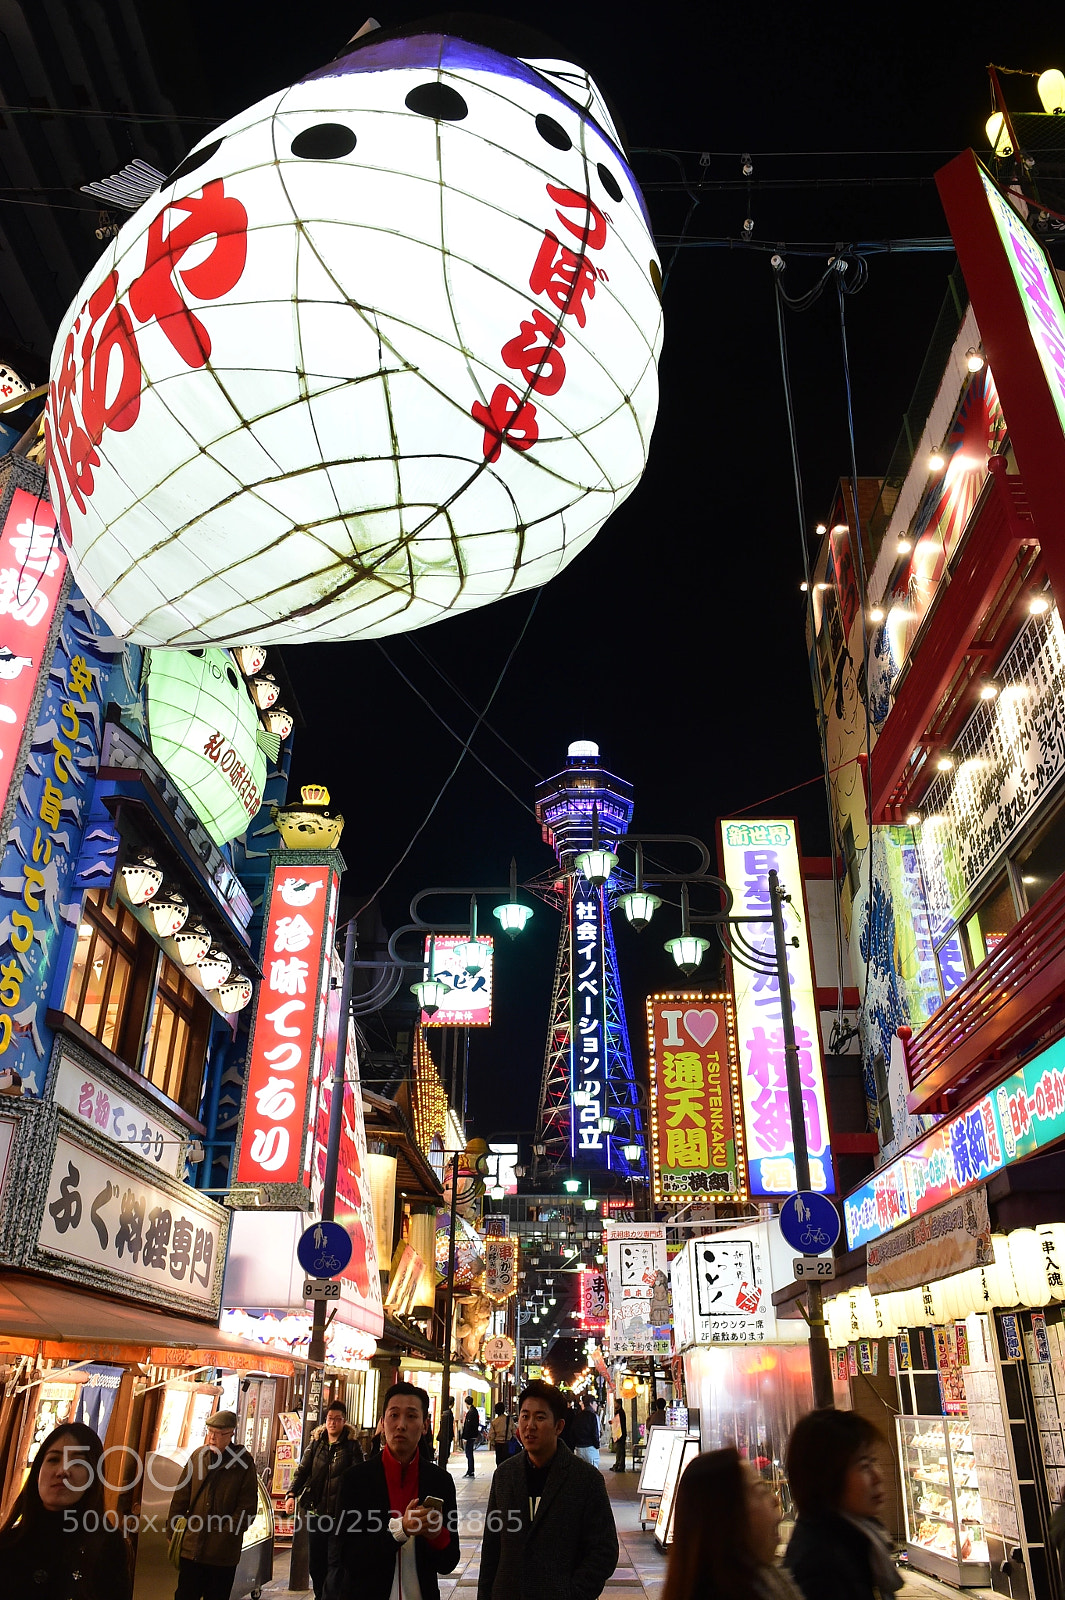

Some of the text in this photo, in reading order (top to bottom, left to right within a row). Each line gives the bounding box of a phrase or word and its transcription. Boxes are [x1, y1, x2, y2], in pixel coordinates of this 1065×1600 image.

[727, 825, 791, 847] 新世界
[437, 1010, 474, 1021] 年中無休
[575, 900, 603, 1150] 社会イノベーションの日立
[249, 913, 314, 1172] 珍味てっちり
[745, 1025, 822, 1153] 横綱
[1010, 1068, 1065, 1137] 日本一の串か
[78, 1081, 164, 1162] 名物てっちり
[662, 1050, 709, 1169] 通天閣
[706, 1050, 728, 1167] TSUTENKAKU
[951, 1109, 990, 1185] 横綱
[663, 1174, 688, 1182] 日本一の
[664, 1182, 688, 1191] 串かつ
[688, 1171, 730, 1192] 横綱
[49, 1160, 214, 1289] ふぐ料理専門
[610, 1230, 664, 1239] 元祖串カツ専門店
[499, 1244, 514, 1285] 串かつ
[795, 1262, 833, 1276] 9-22
[1040, 1230, 1062, 1286] 一串入魂
[305, 1284, 339, 1297] 9-22
[592, 1275, 605, 1312] 串かつ
[612, 1301, 652, 1321] 大阪名物
[711, 1319, 765, 1329] カウンター席
[613, 1342, 669, 1352] 宴会予約受付中
[712, 1332, 765, 1341] 座敷あります
